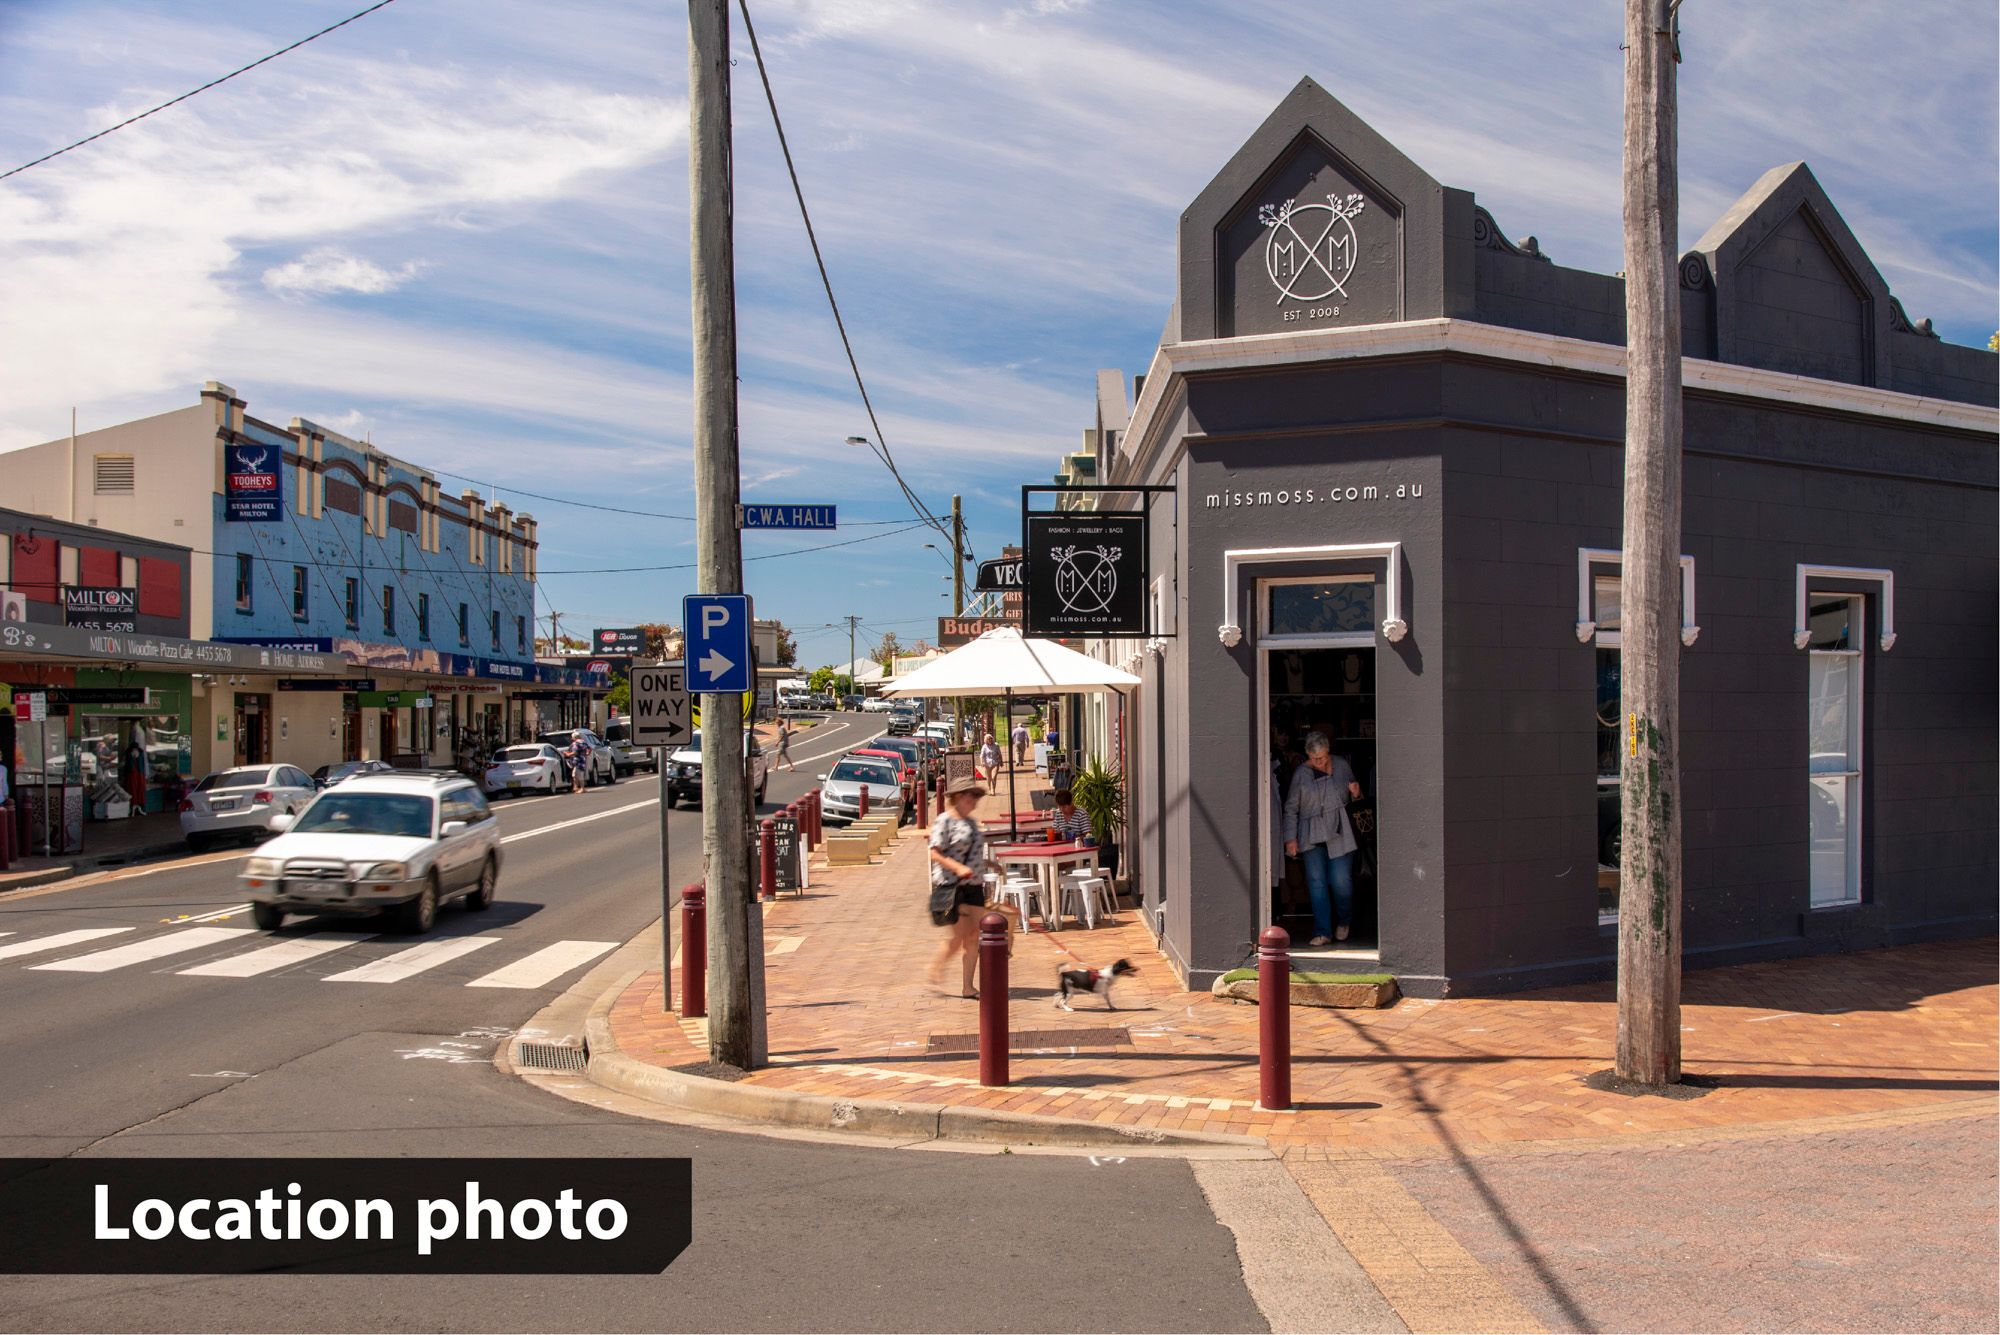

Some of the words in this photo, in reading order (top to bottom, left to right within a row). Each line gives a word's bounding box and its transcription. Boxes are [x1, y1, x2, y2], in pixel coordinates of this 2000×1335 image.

[1283, 310, 1302, 321] EST
[1309, 306, 1340, 319] 2008
[234, 476, 272, 486] TOOHEYS
[1206, 482, 1423, 508] missmoss.com.au
[240, 510, 268, 518] MILTON
[746, 507, 790, 527] C.W.A.
[792, 507, 835, 527] HALL
[67, 590, 134, 605] MILTON
[99, 605, 118, 613] Pizza
[118, 605, 134, 613] Cafe
[105, 622, 135, 633] 5678
[701, 605, 731, 641] P
[602, 632, 618, 640] IGA
[89, 636, 121, 654] MILTON
[160, 642, 178, 659] Pizza
[179, 643, 194, 660] Cafe
[274, 650, 295, 668] HOME
[297, 653, 325, 670] ADDRESS
[589, 663, 609, 673] IGA
[640, 674, 682, 693] ONE
[637, 698, 685, 717] WAY
